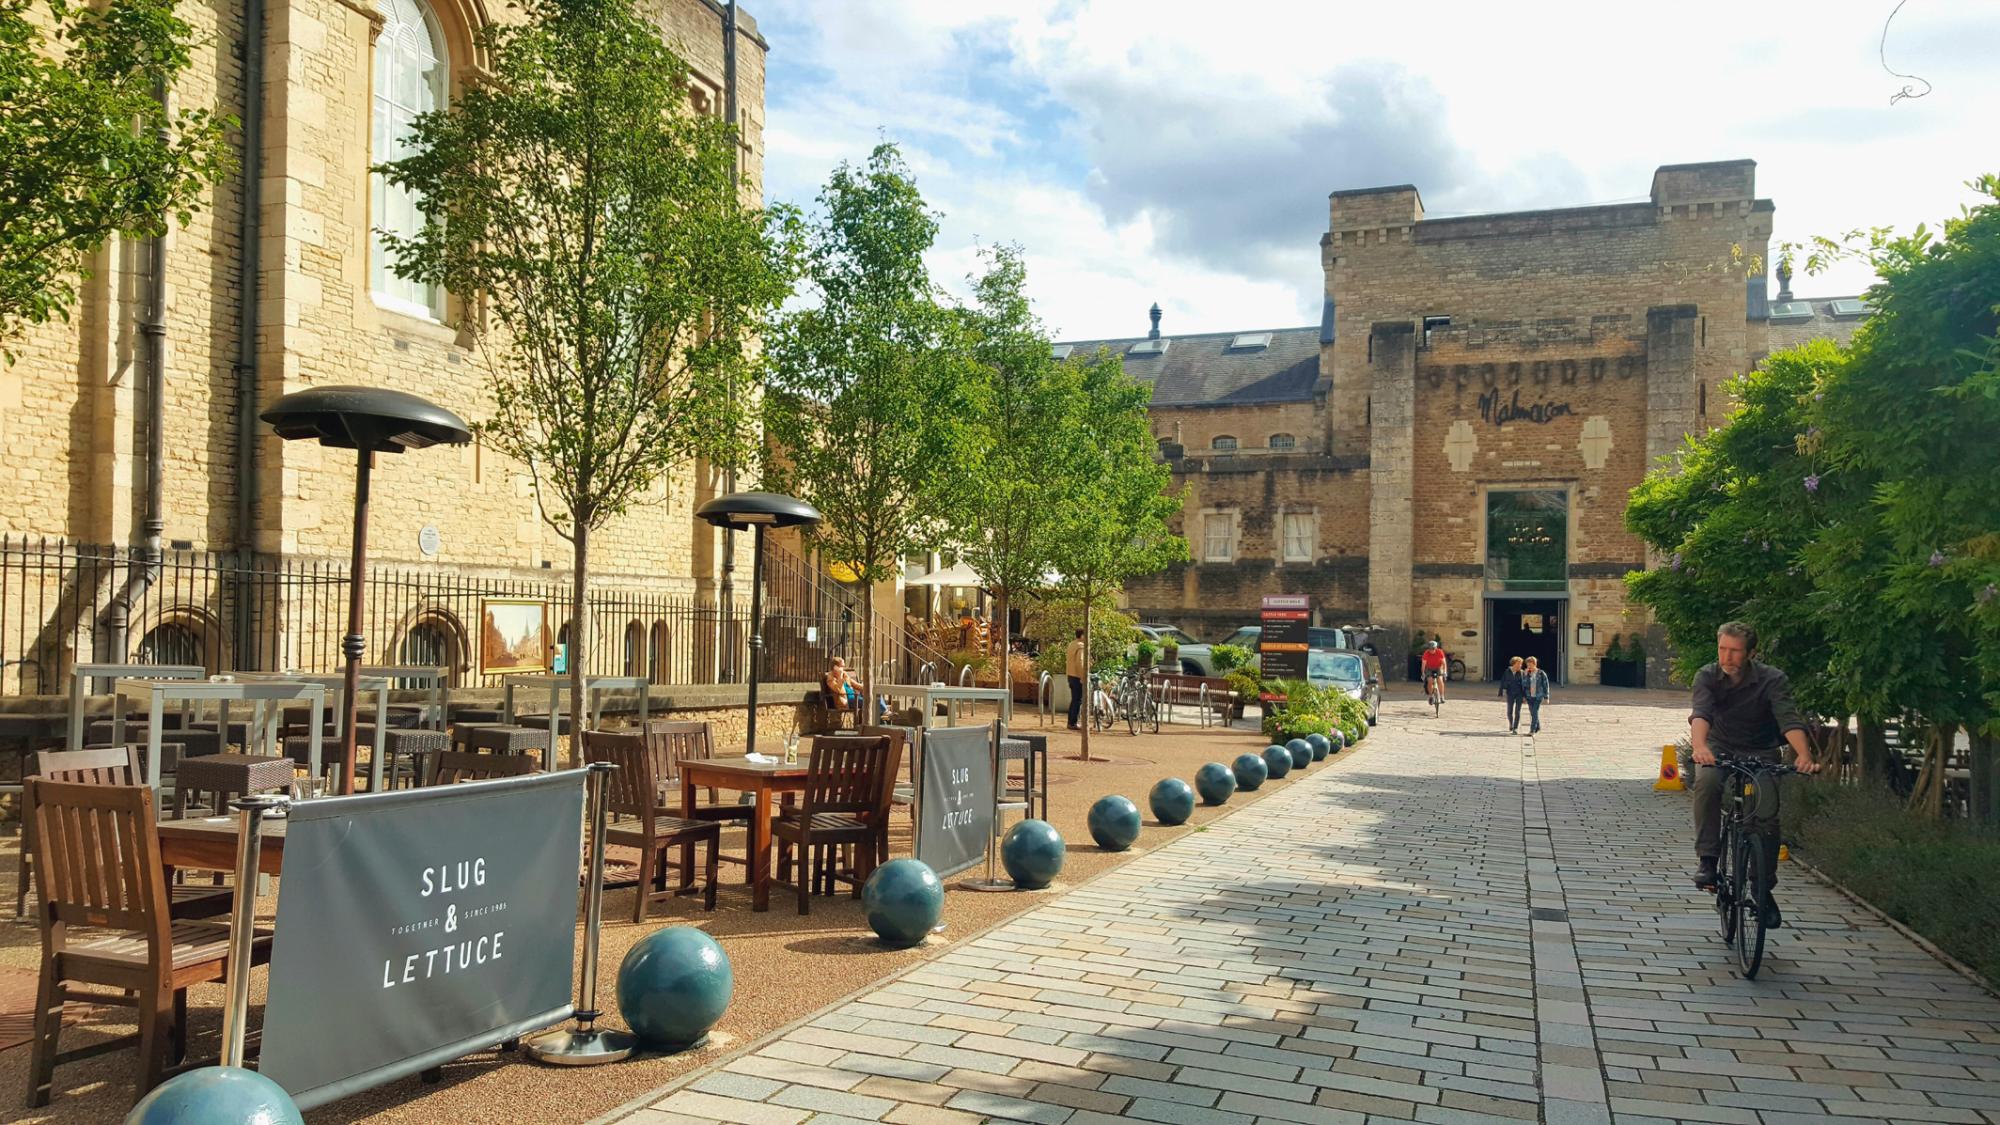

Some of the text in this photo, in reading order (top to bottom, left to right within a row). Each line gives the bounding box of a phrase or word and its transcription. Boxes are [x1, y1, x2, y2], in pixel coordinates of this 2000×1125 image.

[1478, 387, 1577, 426] Malmaison
[952, 767, 969, 785] SLUG
[942, 808, 973, 830] LETTUCE
[421, 857, 486, 897] SLUG
[391, 918, 439, 935] TOGETHER
[444, 904, 458, 933] &
[464, 906, 489, 919] SINCE
[383, 931, 504, 989] LETTUCE
